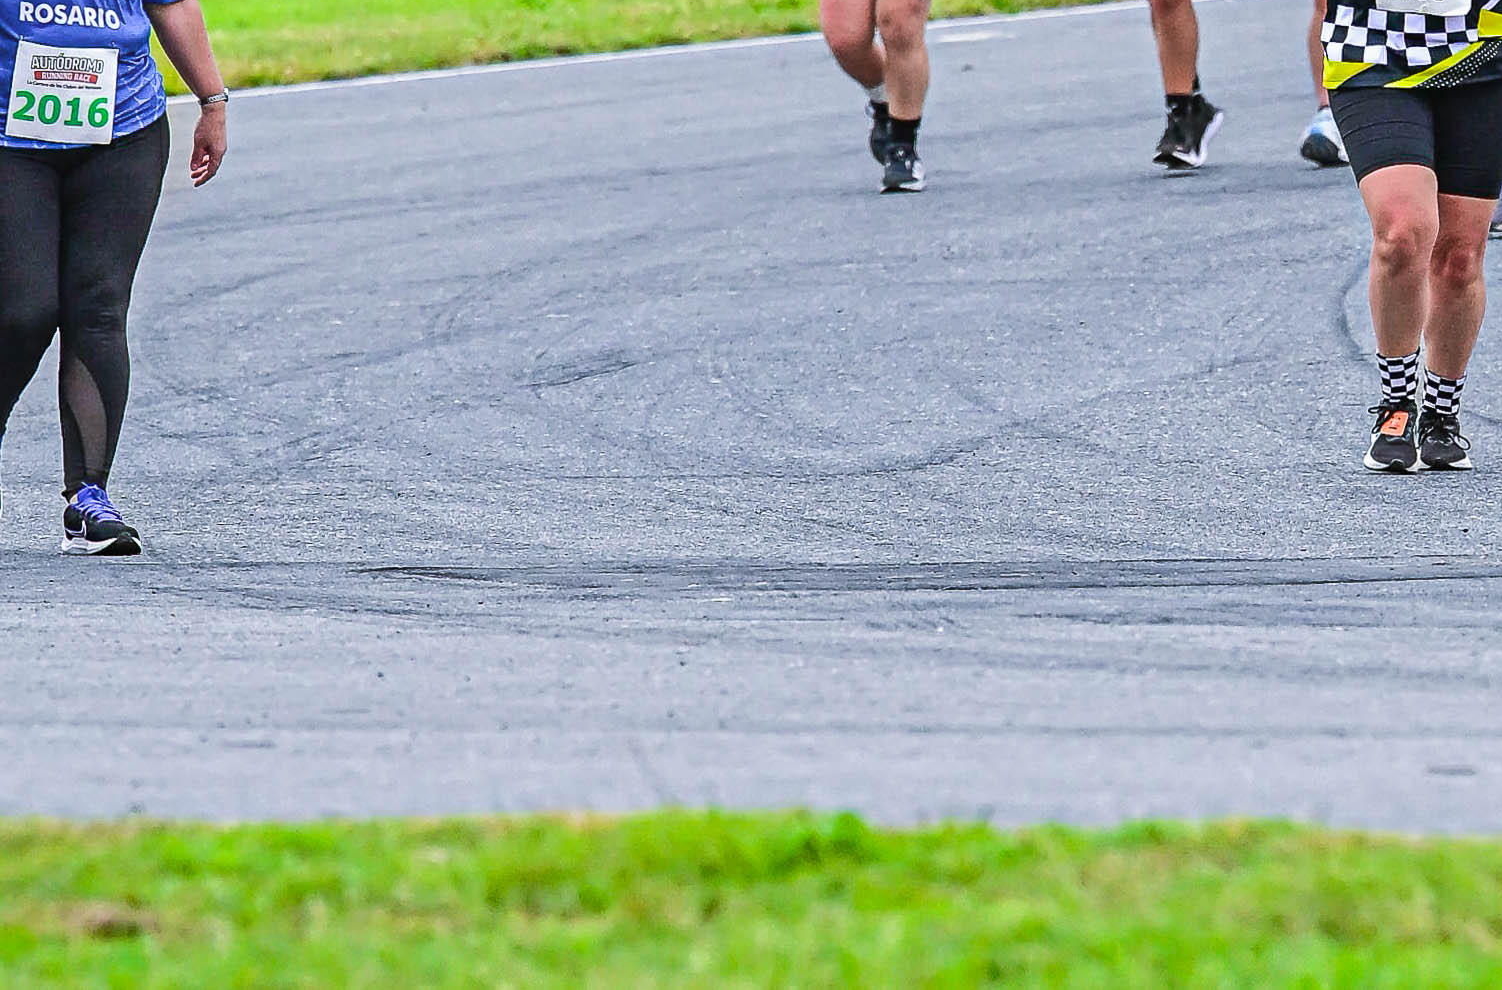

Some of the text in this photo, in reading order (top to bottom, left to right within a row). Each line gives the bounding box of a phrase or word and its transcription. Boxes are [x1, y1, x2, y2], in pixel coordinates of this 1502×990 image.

[19, 1, 121, 30] ROSARIO
[31, 52, 104, 73] AUTÓDROMO
[12, 90, 109, 128] 2016
